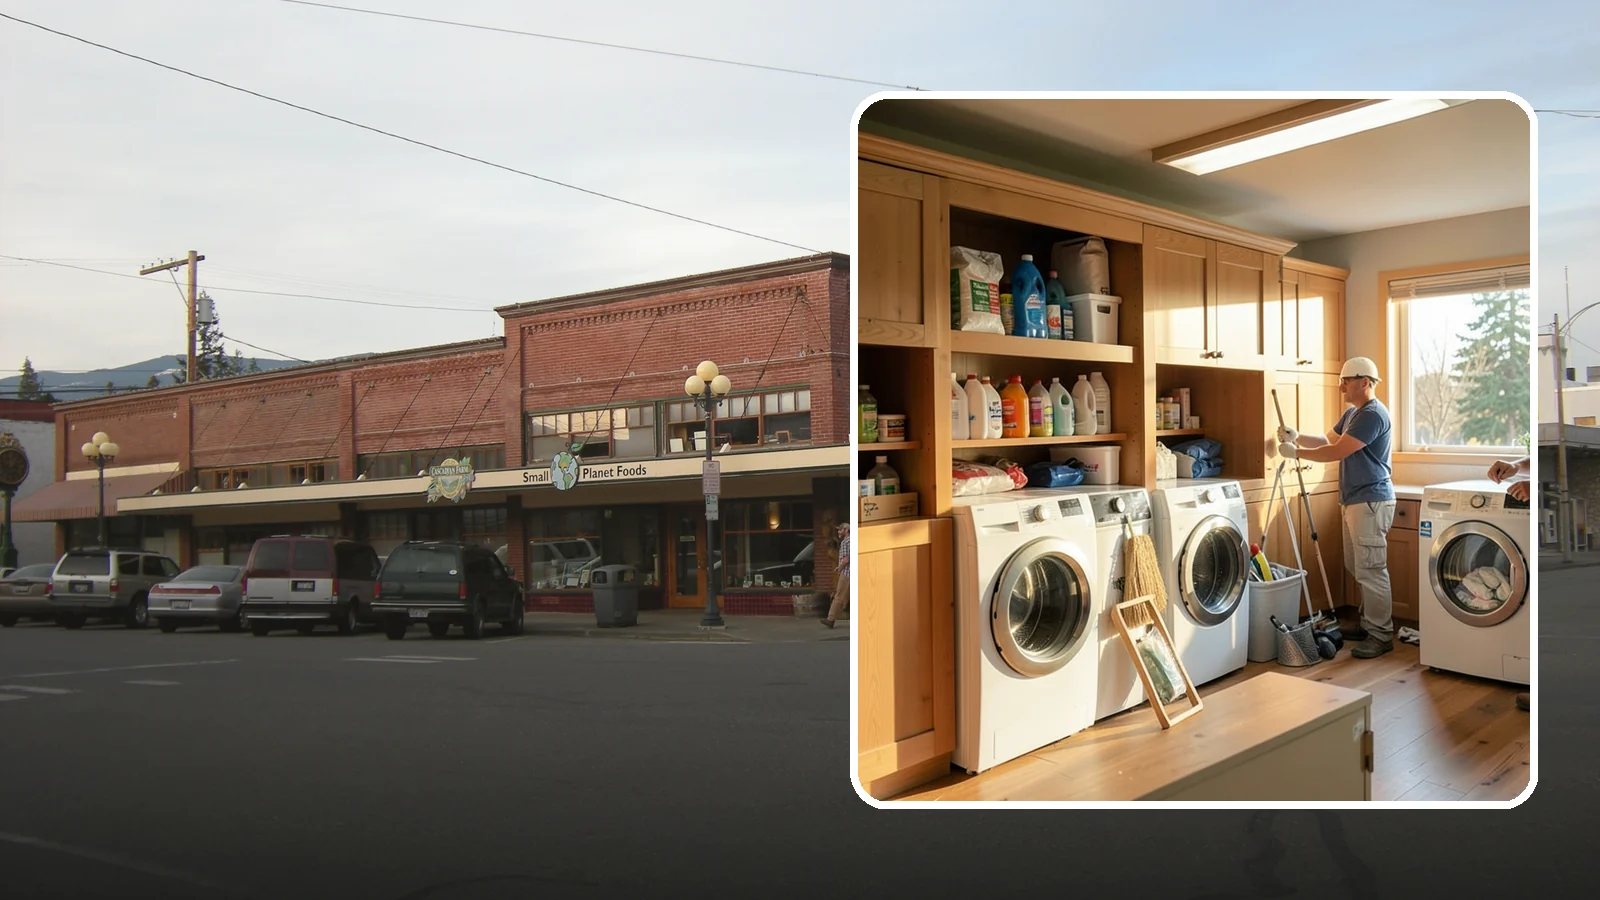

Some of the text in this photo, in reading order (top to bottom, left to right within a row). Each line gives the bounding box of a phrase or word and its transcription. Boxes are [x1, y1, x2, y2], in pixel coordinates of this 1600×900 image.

[523, 464, 647, 483] Small Planet Foods
